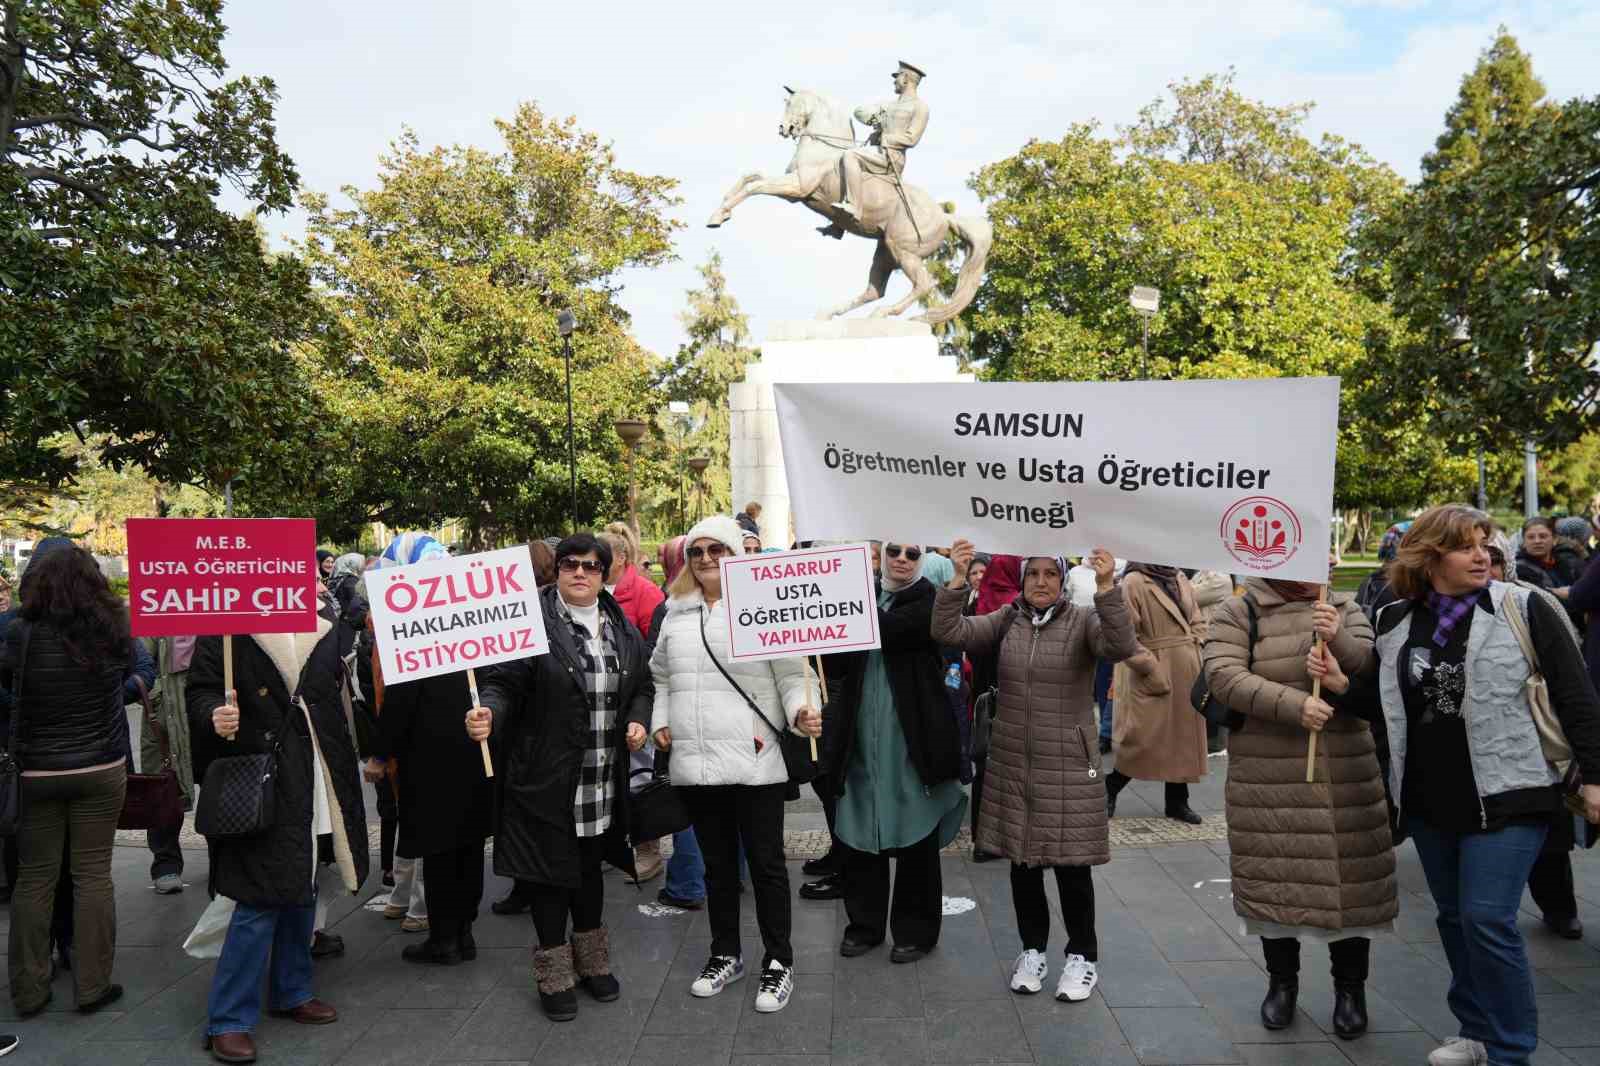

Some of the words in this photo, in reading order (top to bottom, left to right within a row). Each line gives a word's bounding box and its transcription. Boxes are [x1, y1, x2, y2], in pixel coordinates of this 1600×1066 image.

[954, 412, 1083, 438] SAMSUN
[824, 442, 967, 480] Öğretmenler
[975, 461, 1007, 481] ve
[1019, 457, 1084, 485] Usta
[1098, 454, 1271, 492] Öğreticiler
[971, 496, 1075, 529] Derneği
[196, 537, 252, 550] M.E.B.
[140, 561, 189, 575] USTA
[195, 557, 306, 575] ÖĞRETİCİNE
[751, 558, 842, 582] TASARRUF
[140, 582, 241, 613] SAHİP
[252, 587, 307, 617] ÇIK
[384, 561, 525, 614] ÖZLÜK
[776, 583, 822, 601] USTA
[392, 602, 528, 641] HAKLARIMIZI
[738, 601, 864, 627] ÖĞRETİCİDEN
[758, 624, 848, 647] YAPILMAZ
[395, 629, 535, 674] İSTİYORUZ
